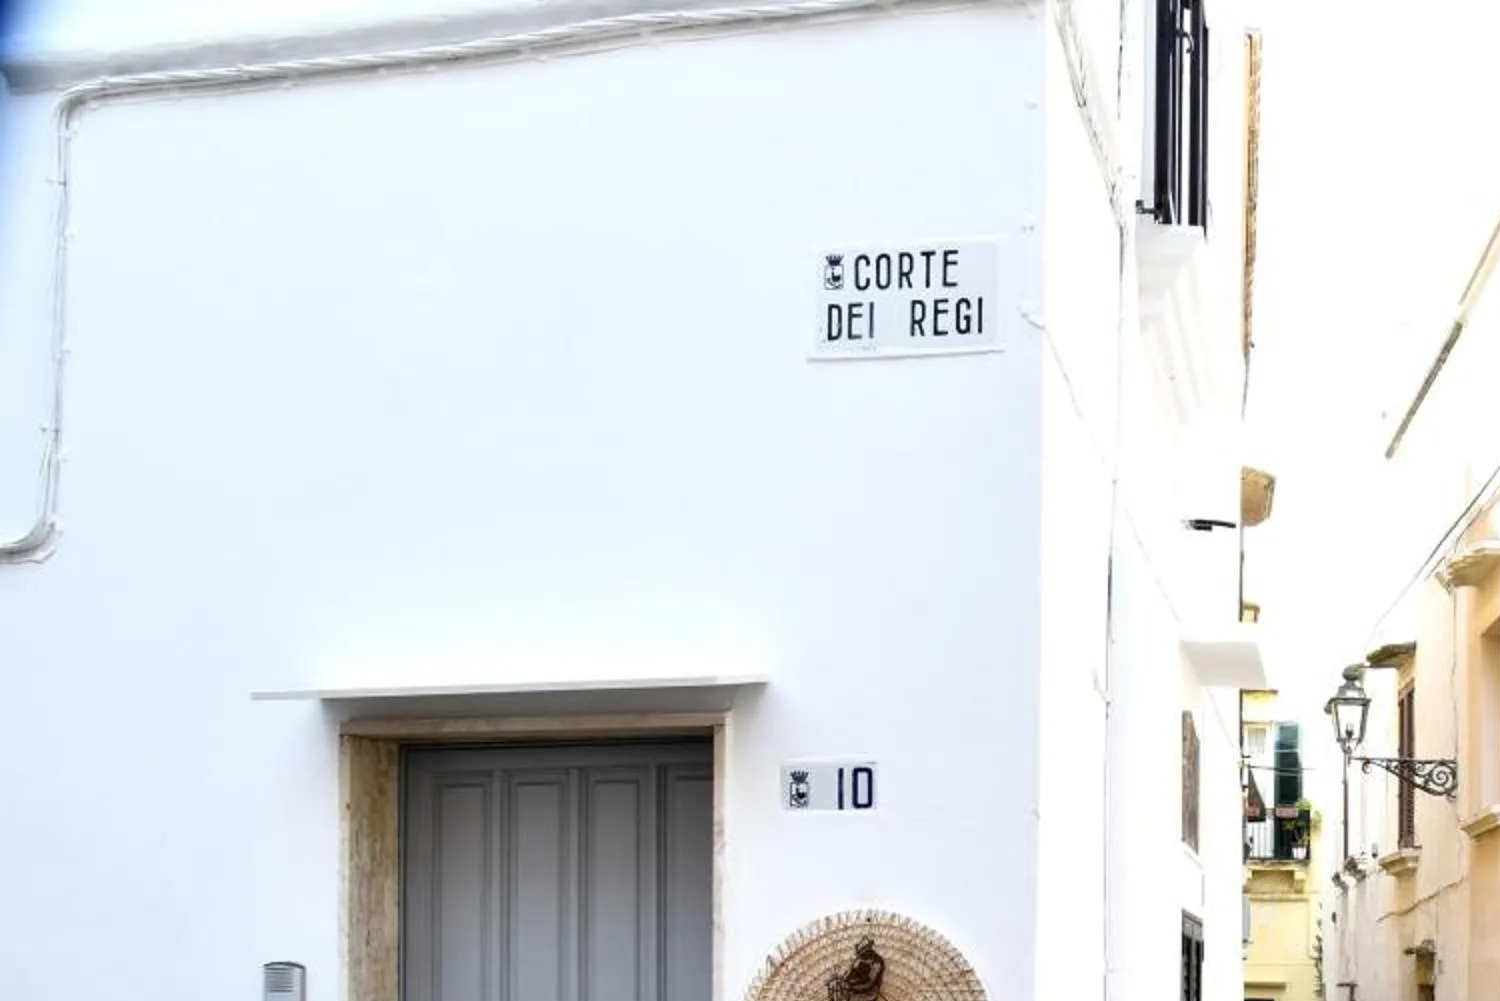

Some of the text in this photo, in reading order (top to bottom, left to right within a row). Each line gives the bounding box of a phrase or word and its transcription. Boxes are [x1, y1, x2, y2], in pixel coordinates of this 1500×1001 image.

[854, 249, 959, 291] CORTE
[827, 296, 984, 341] DEI REGI
[837, 767, 873, 810] 10
